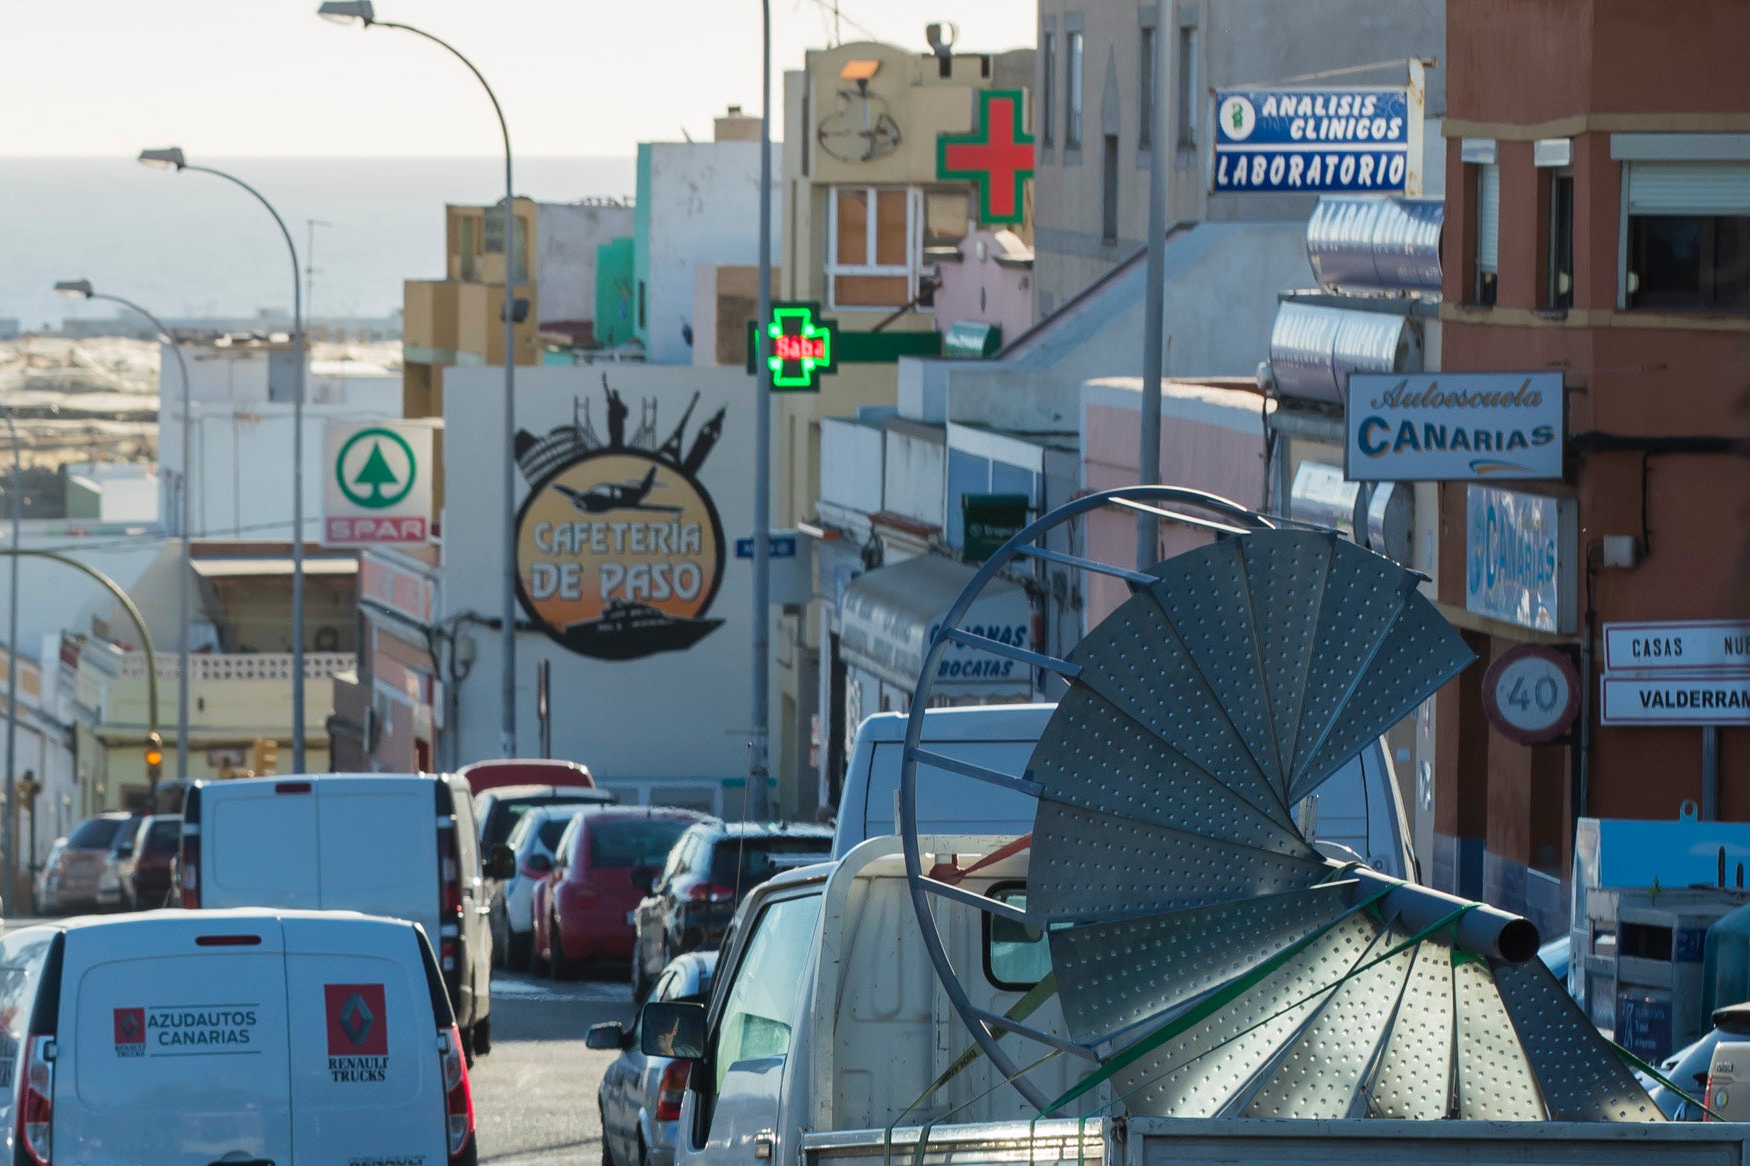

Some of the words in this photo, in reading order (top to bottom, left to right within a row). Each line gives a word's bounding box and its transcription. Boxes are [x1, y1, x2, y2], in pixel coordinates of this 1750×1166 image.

[1262, 95, 1377, 118] ANALISIS
[1290, 117, 1402, 140] CLINICOS
[1217, 154, 1405, 187] LABORATORIO
[1371, 378, 1543, 410] Autoescuela
[1358, 415, 1556, 458] CANARIAS
[330, 519, 425, 541] SPAR
[534, 511, 702, 554] CAFETERÍA
[530, 562, 584, 599] DE
[600, 562, 702, 599] PASO
[1632, 638, 1683, 657] CASAS
[938, 660, 1014, 678] BOCATAS
[1507, 676, 1558, 711] 40
[147, 1011, 257, 1028] AZUDAUTOS
[158, 1029, 251, 1046] CANARIAS
[328, 1056, 389, 1070] RENAULT
[331, 1069, 386, 1082] TRUCKS
